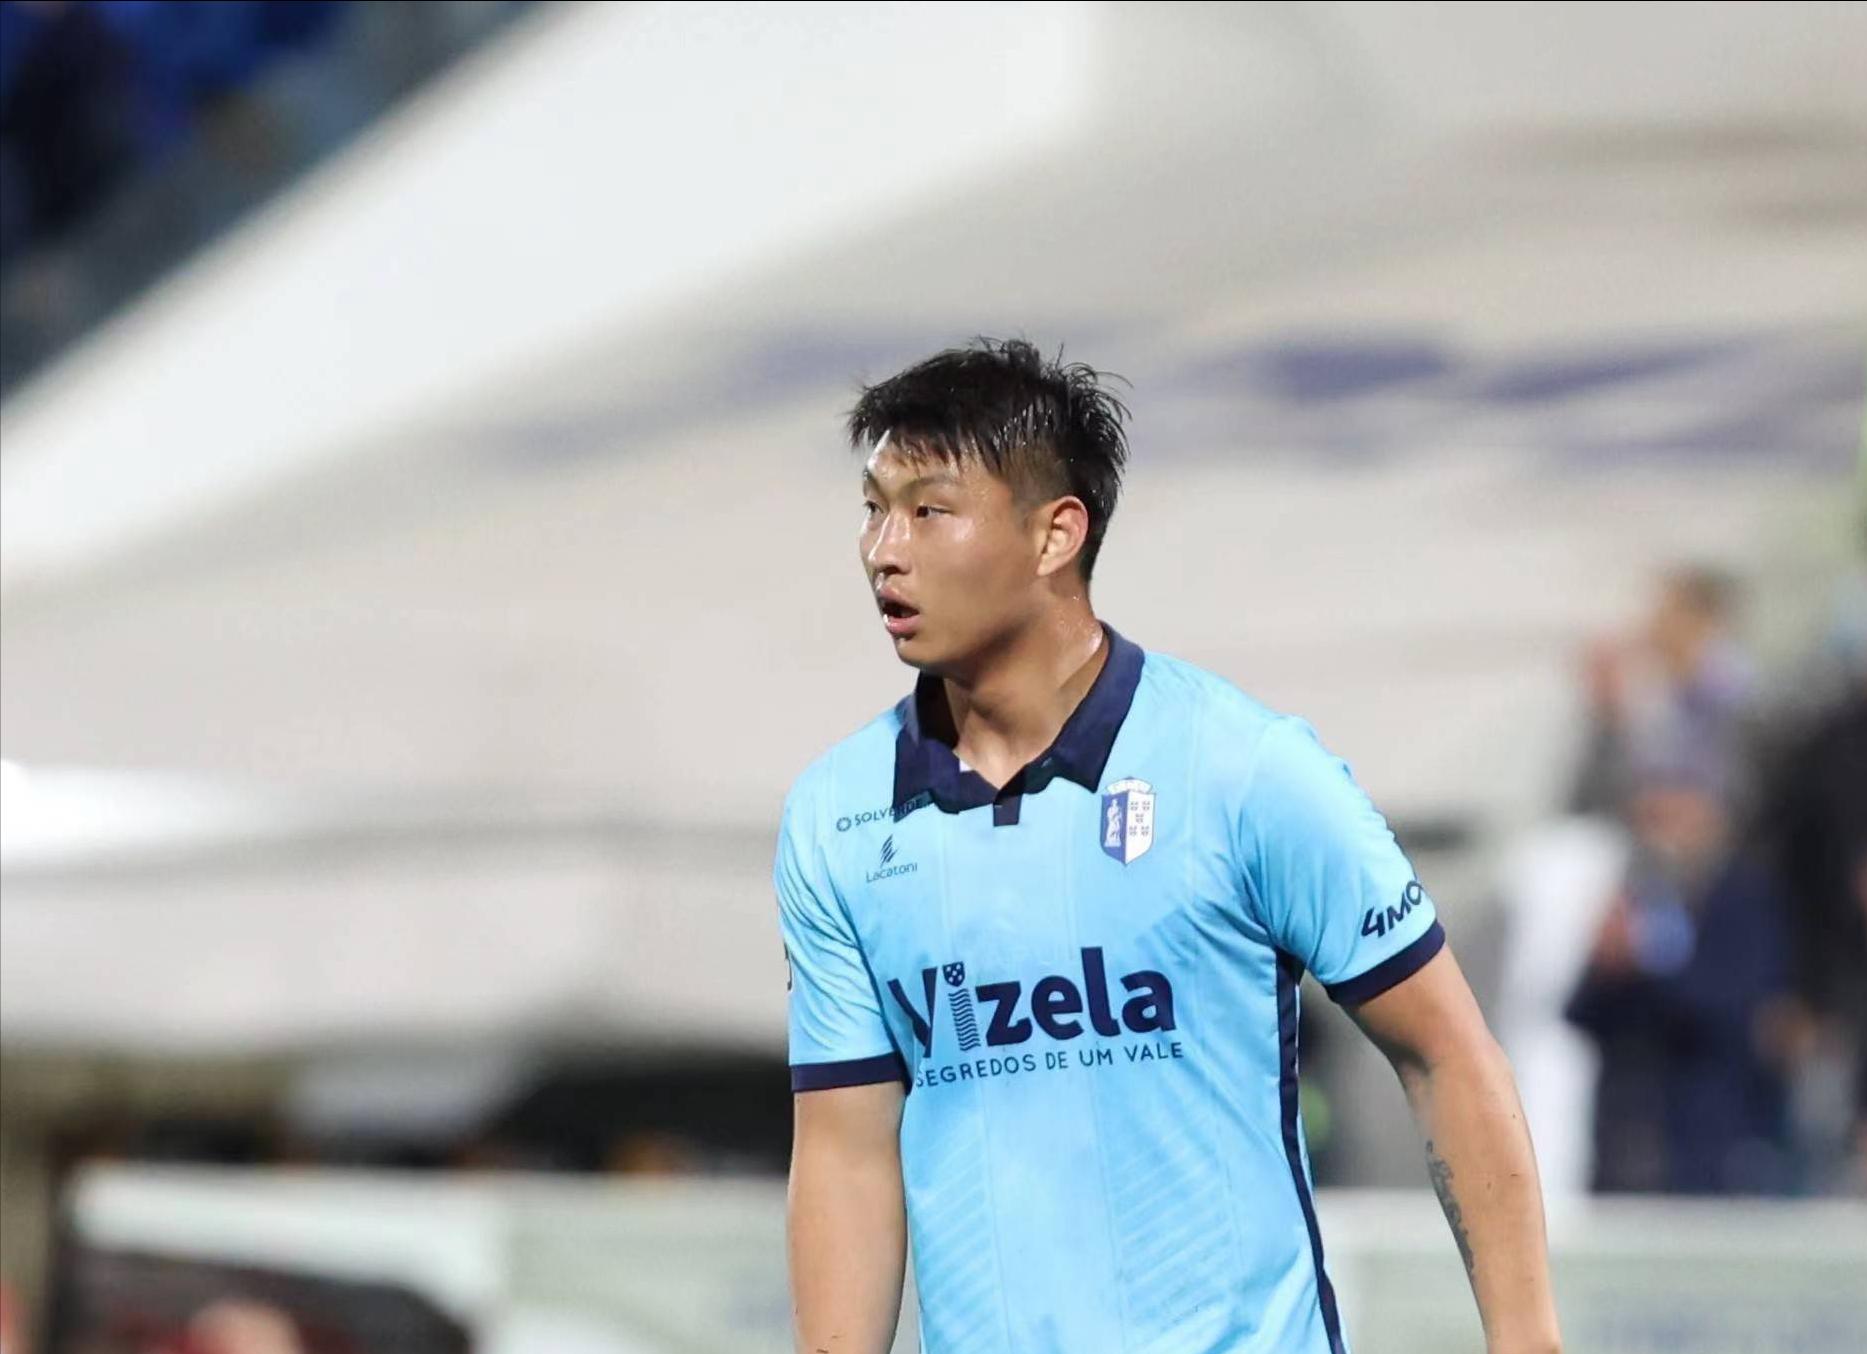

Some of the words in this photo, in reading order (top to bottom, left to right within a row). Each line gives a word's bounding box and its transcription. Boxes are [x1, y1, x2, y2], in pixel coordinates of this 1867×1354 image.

[866, 862, 918, 884] Lacatoni
[1361, 880, 1424, 938] 4MO
[887, 946, 1176, 1058] Vizela
[1045, 1051, 1069, 1070] DE
[1079, 1048, 1114, 1067] UM
[1123, 1042, 1184, 1062] VALE
